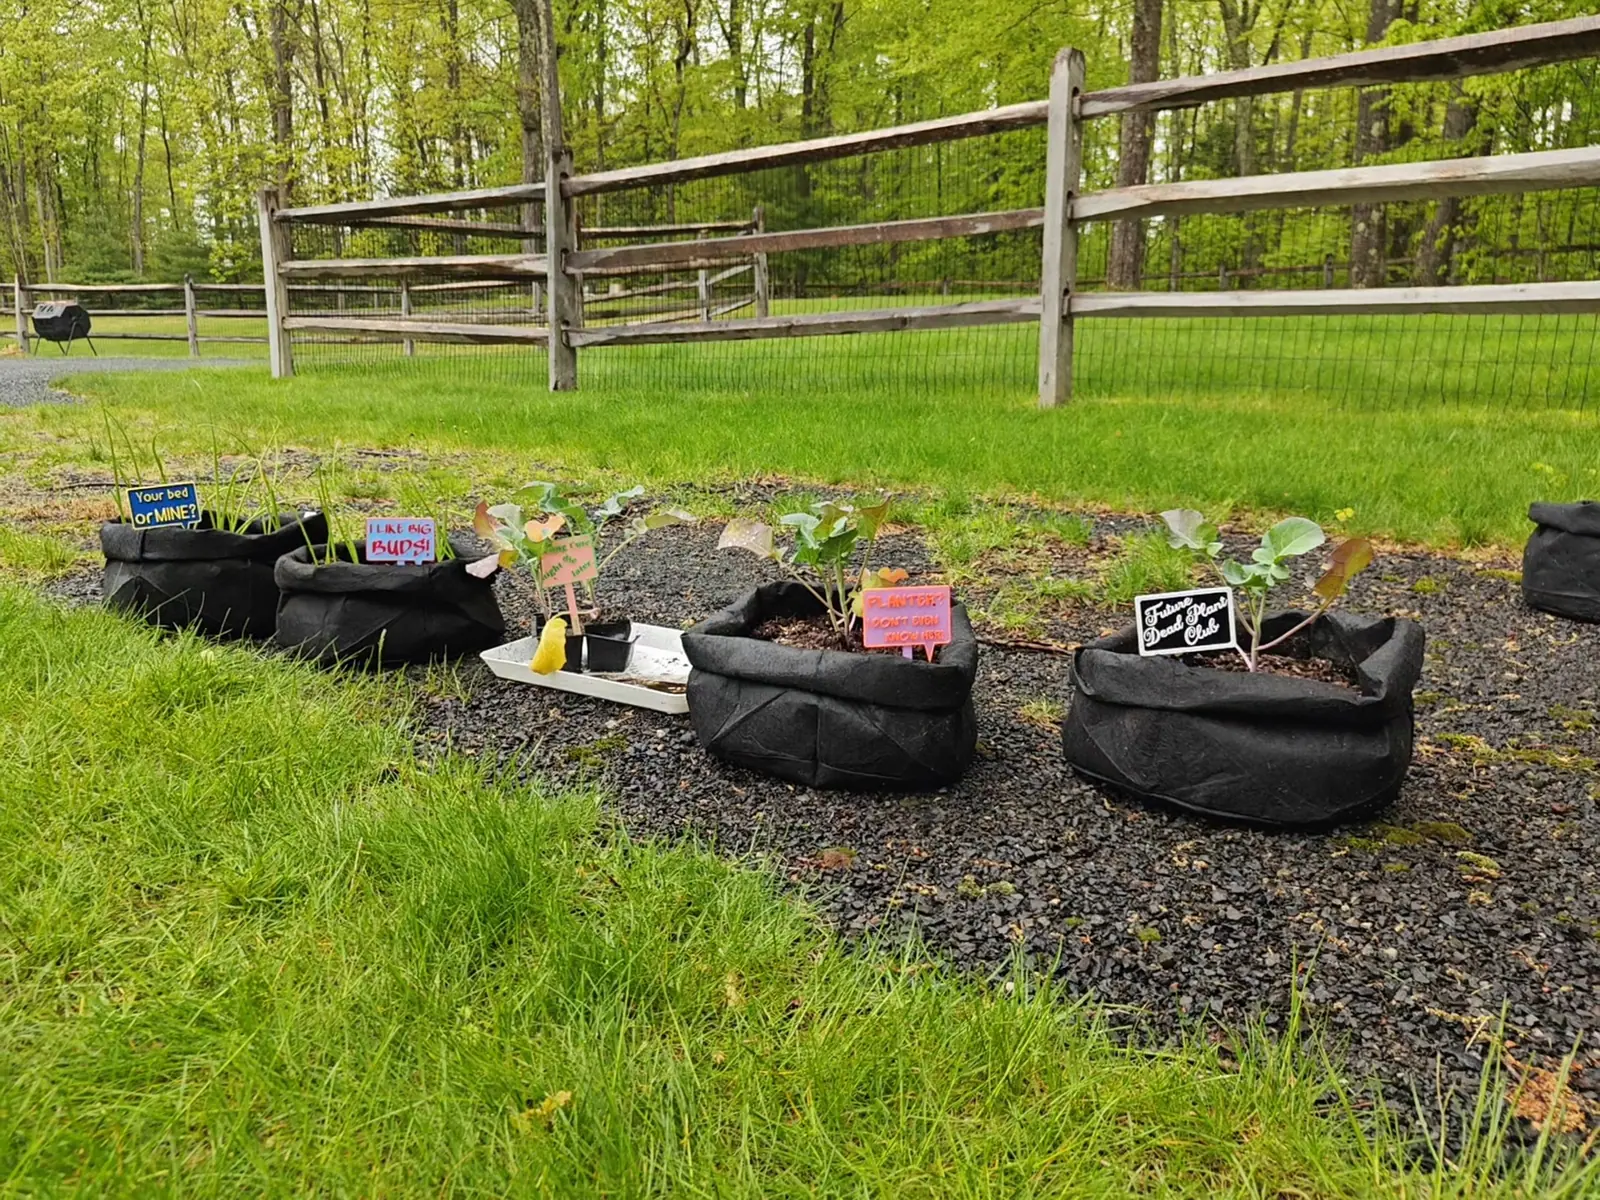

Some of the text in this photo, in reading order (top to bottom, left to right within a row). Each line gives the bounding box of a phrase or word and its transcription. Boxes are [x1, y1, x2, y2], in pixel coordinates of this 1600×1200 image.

[135, 487, 189, 503] Your bed
[154, 503, 197, 523] MINE?
[369, 523, 432, 535] I LIKE BIG
[372, 538, 430, 557] BUDS!
[912, 613, 939, 626] EVEN
[1143, 596, 1228, 647] Dead Plant
[1144, 597, 1193, 627] Future
[884, 630, 919, 642] KNOW
[1184, 617, 1220, 645] Club
